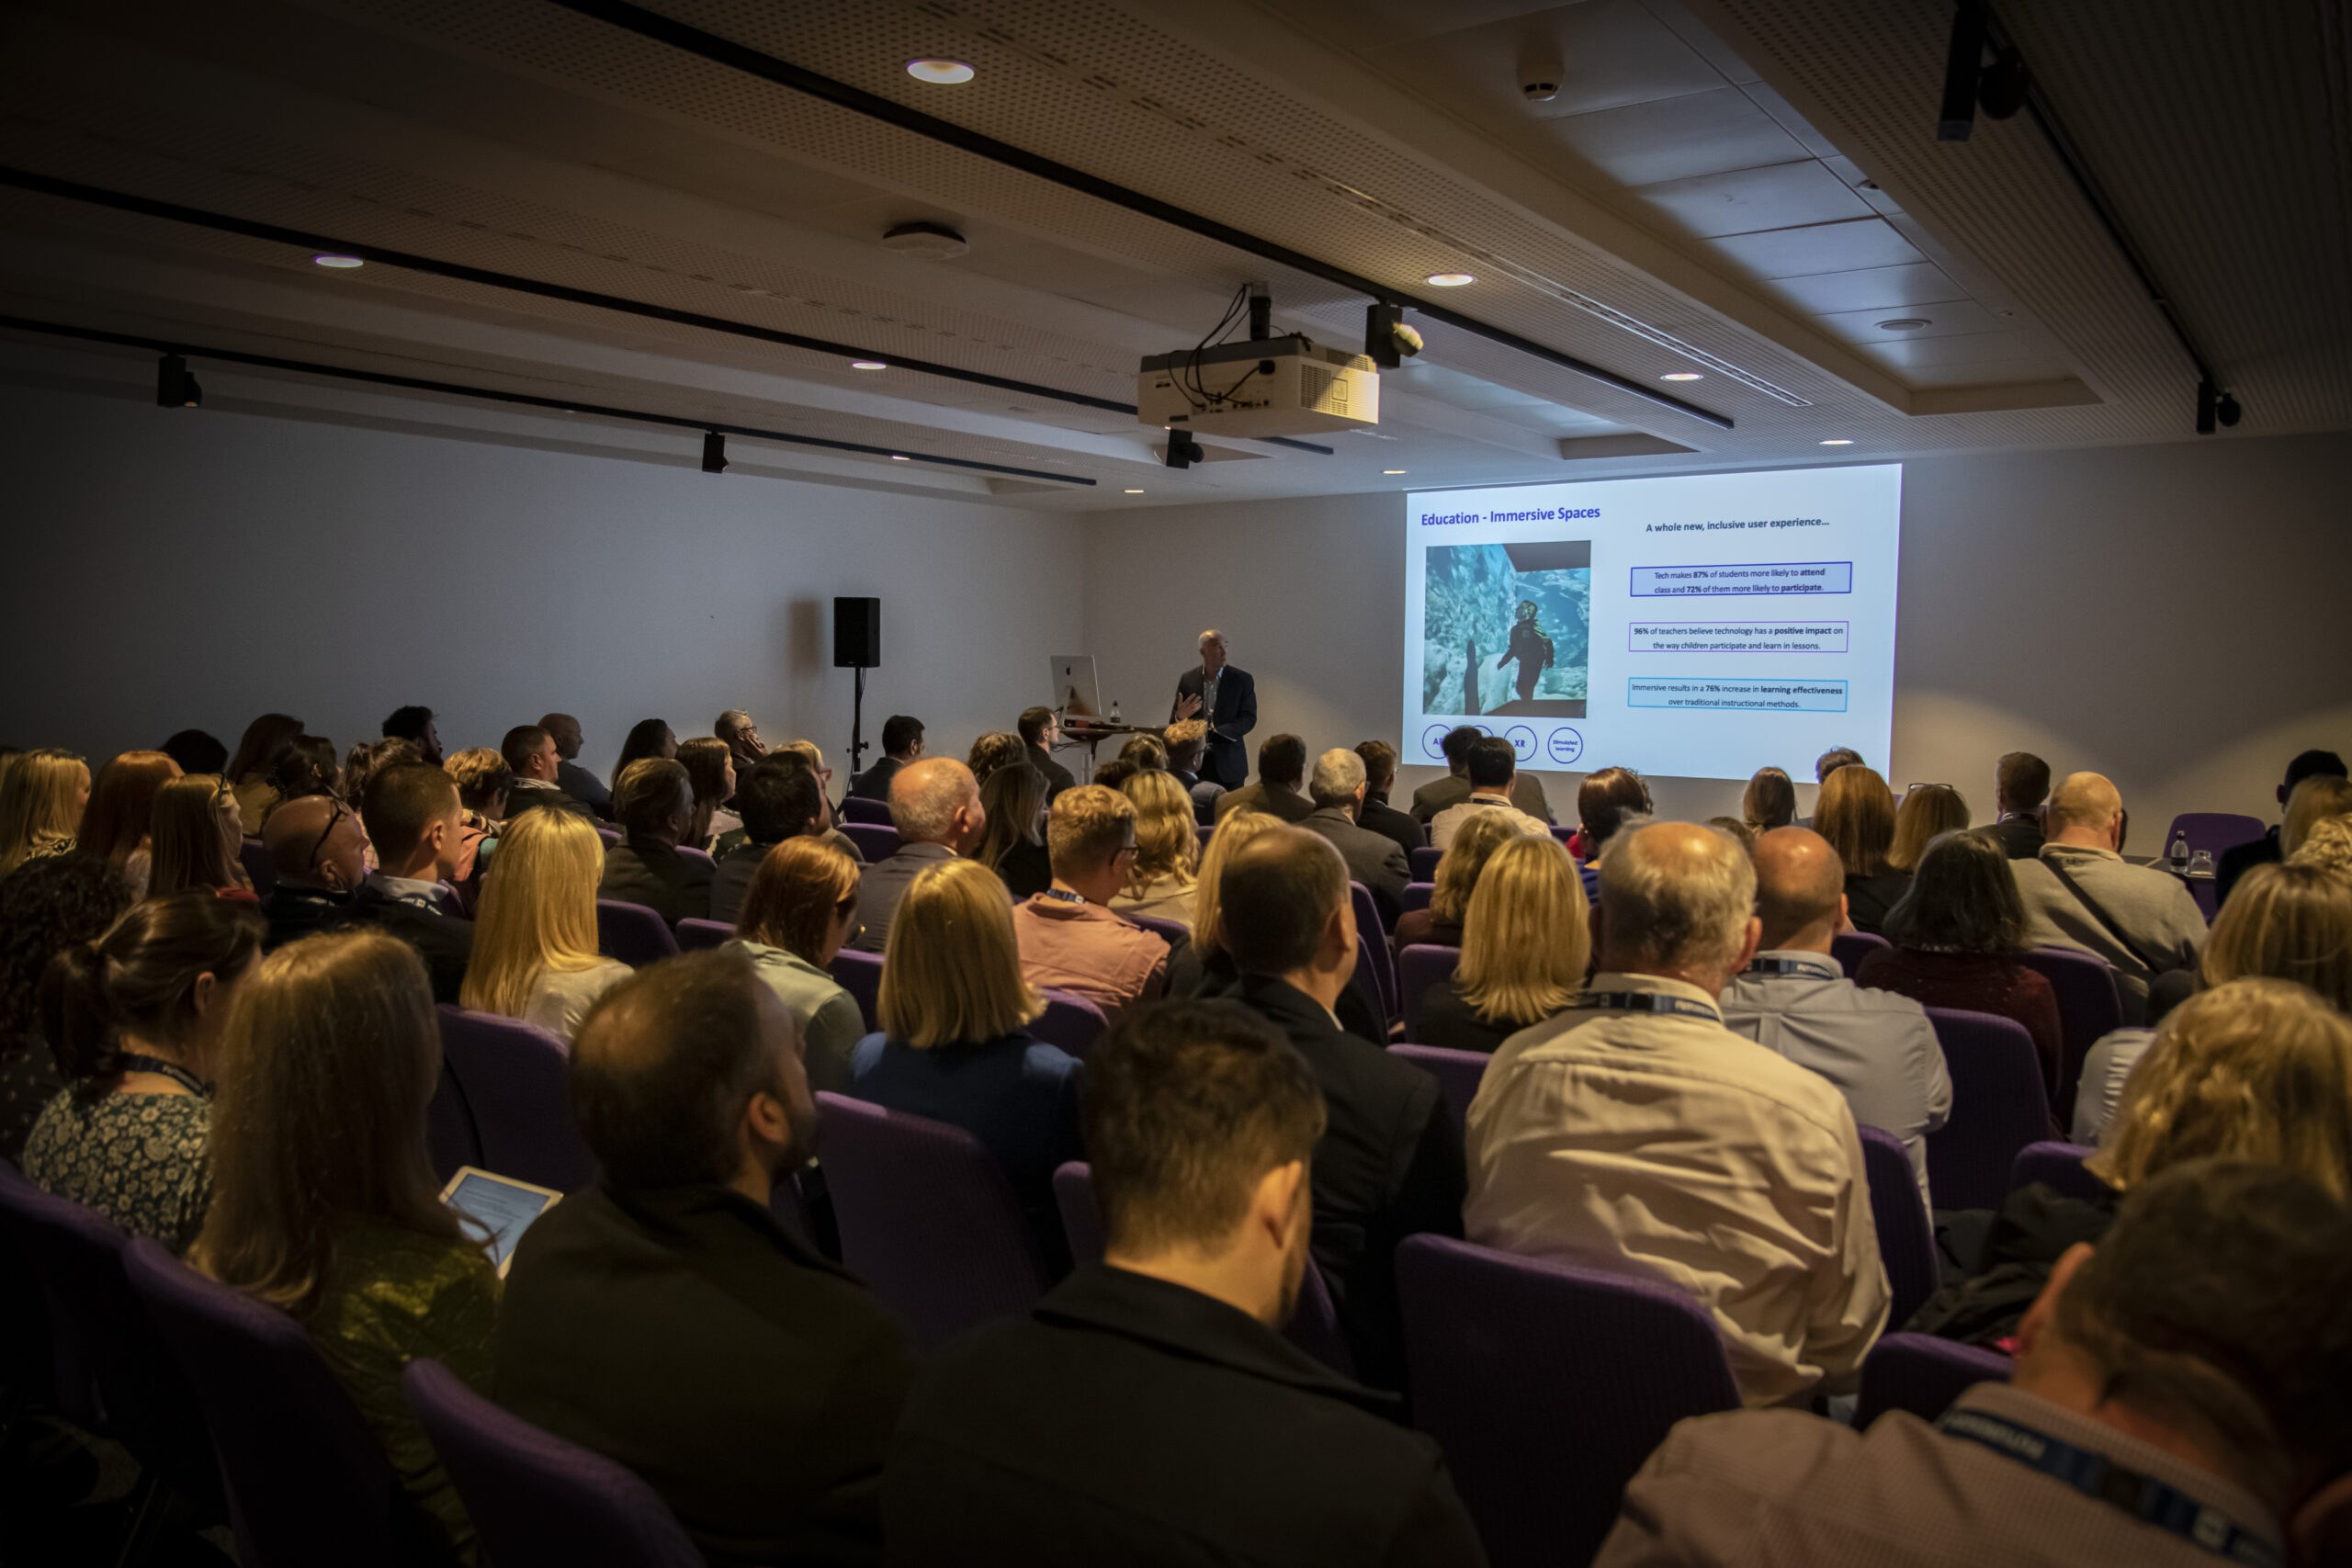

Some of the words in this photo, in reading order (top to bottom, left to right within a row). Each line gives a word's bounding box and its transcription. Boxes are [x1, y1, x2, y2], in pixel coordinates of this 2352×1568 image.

[1421, 512, 1479, 526] Education
[1490, 508, 1555, 523] Immersive
[1557, 507, 1600, 522] Spaces
[1645, 524, 1653, 532] A
[1654, 522, 1682, 532] whole
[1683, 524, 1705, 532] new,
[1707, 520, 1746, 530] inclusive
[1654, 571, 1669, 580] Tech
[1692, 570, 1709, 579] 87%
[1718, 570, 1749, 578] students
[1770, 569, 1790, 578] likely
[1799, 568, 1826, 576] attend
[1671, 585, 1685, 593] and
[1686, 585, 1702, 593] 72%
[1702, 585, 1711, 593] of
[1752, 584, 1771, 592] likely
[1781, 583, 1825, 593] participate.
[1714, 626, 1753, 637] technology
[1754, 626, 1767, 635] has
[1773, 626, 1804, 636] positive
[1804, 626, 1832, 636] impact
[1652, 641, 1665, 649] the
[1680, 641, 1709, 649] children
[1709, 641, 1747, 650] participate
[1747, 641, 1762, 649] and
[1762, 641, 1782, 649] learn
[1792, 641, 1821, 649] lessons.
[1632, 683, 1667, 692] Immersive
[1705, 684, 1721, 693] 76%
[1760, 685, 1792, 695] learning
[1792, 685, 1843, 694] effectiveness
[1684, 698, 1720, 706] traditional
[1721, 699, 1765, 707] instructional
[1766, 700, 1801, 708] methods.
[1514, 739, 1525, 748] XR
